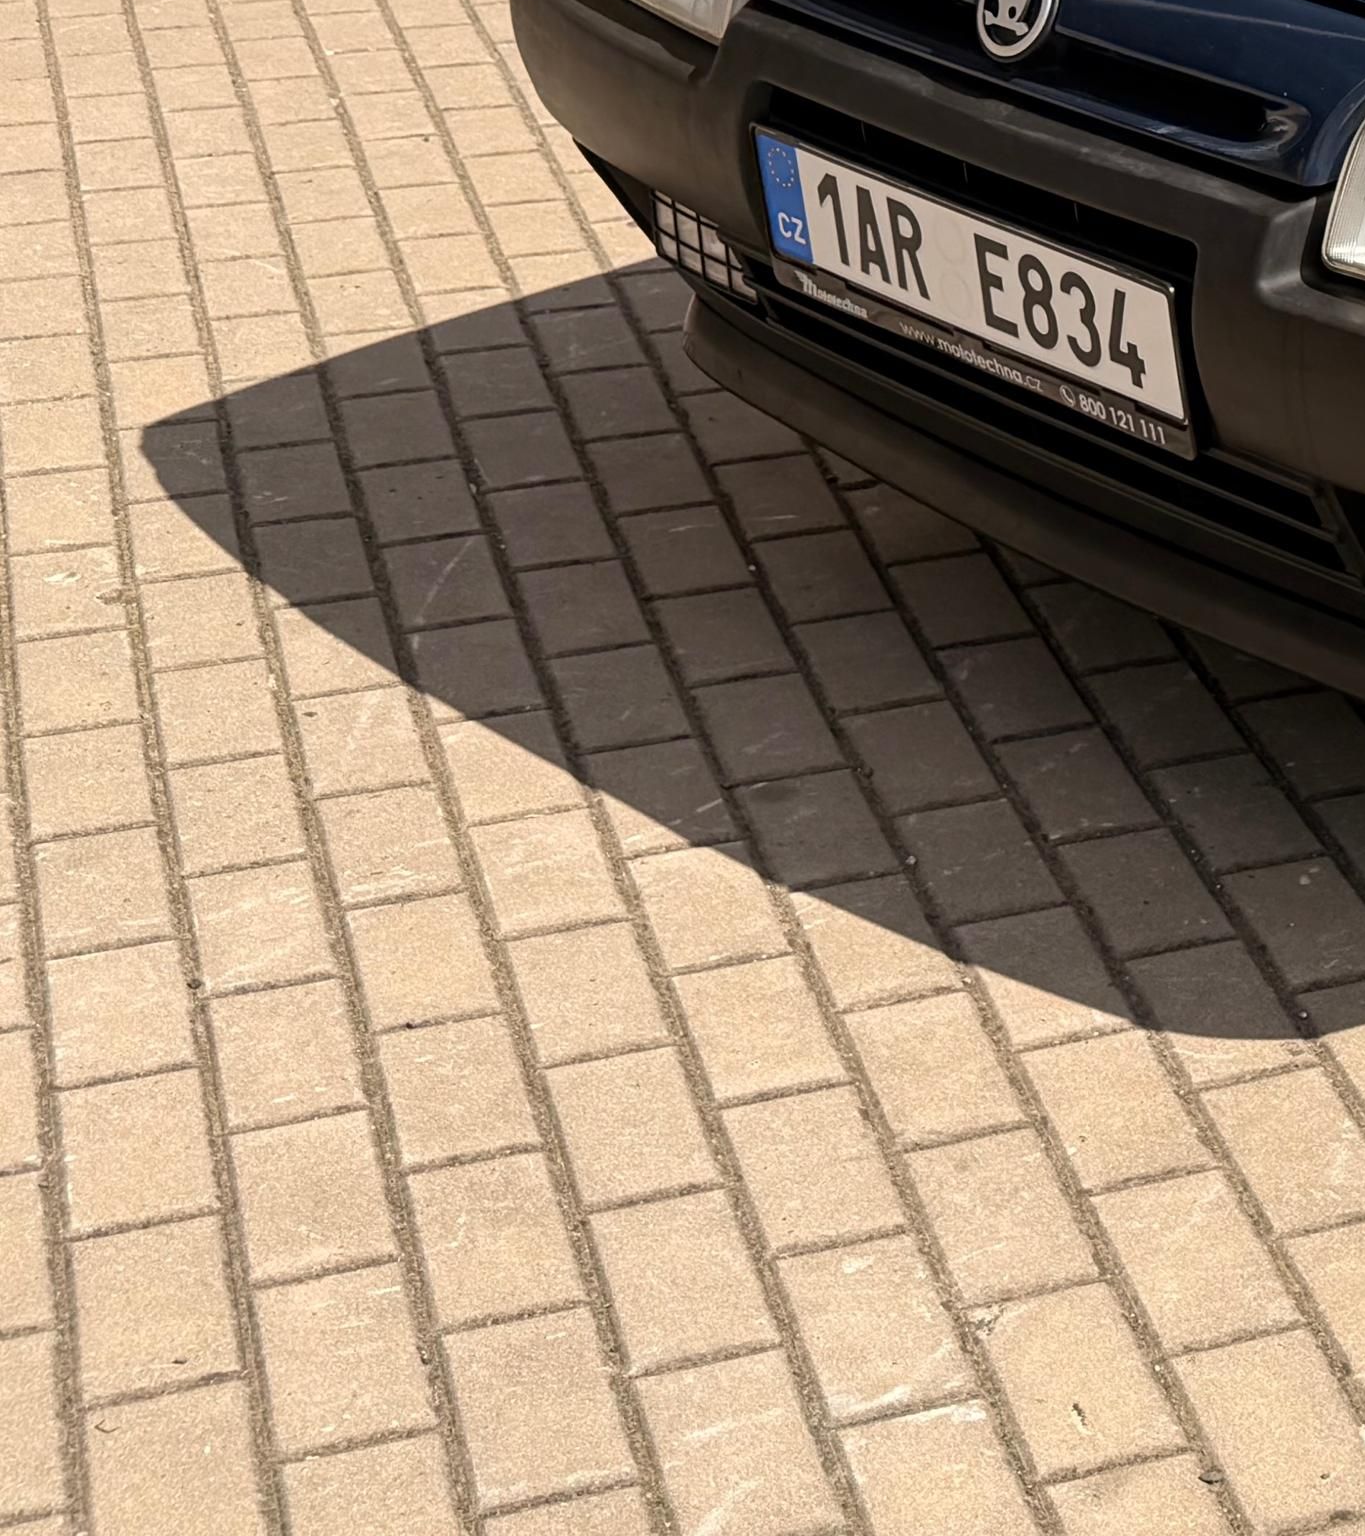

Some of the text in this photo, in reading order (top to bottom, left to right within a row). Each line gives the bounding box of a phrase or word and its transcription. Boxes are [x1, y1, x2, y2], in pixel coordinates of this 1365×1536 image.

[777, 211, 807, 245] CZ
[816, 172, 1147, 390] 1AR E834
[795, 270, 1166, 445] Mototechna www.mototechna.cz 800 121 111
